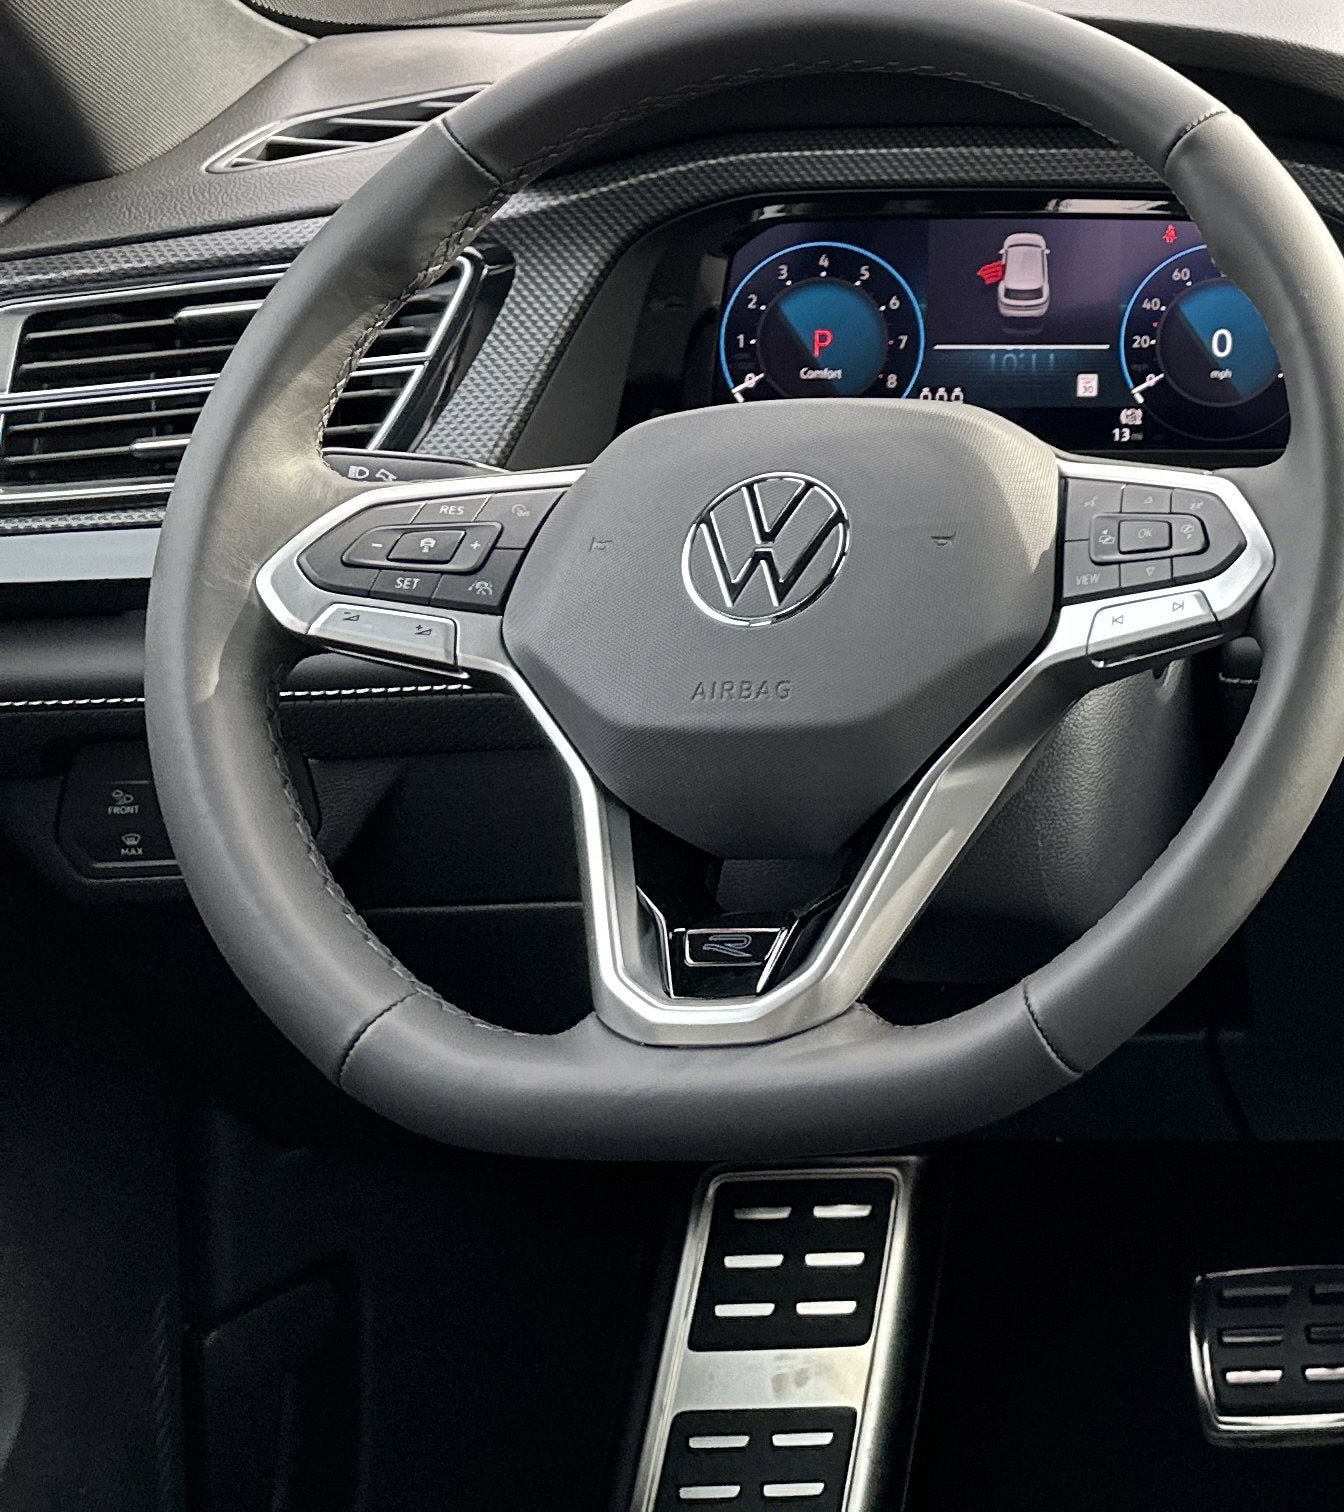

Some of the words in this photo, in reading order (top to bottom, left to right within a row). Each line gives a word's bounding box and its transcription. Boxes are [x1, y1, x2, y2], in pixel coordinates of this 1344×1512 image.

[818, 254, 830, 268] 4
[777, 264, 788, 280] 3
[859, 265, 870, 280] 5
[1172, 268, 1190, 281] 60
[747, 294, 758, 310] 2
[889, 295, 900, 310] 6
[1141, 297, 1161, 312] 40
[736, 334, 745, 348] 1
[812, 329, 833, 358] P
[898, 334, 908, 350] 7
[1131, 335, 1151, 348] 20
[1211, 328, 1233, 358] 0
[799, 366, 842, 380] Comfort
[1209, 369, 1233, 380] mph
[886, 373, 898, 389] 8
[1112, 428, 1131, 442] 13
[439, 504, 465, 516] RES
[1137, 527, 1153, 539] OK
[395, 577, 420, 591] SET
[1075, 573, 1101, 586] VIEW
[690, 679, 793, 702] AIRBAG
[107, 804, 140, 815] FRONT
[120, 847, 144, 856] MAX
